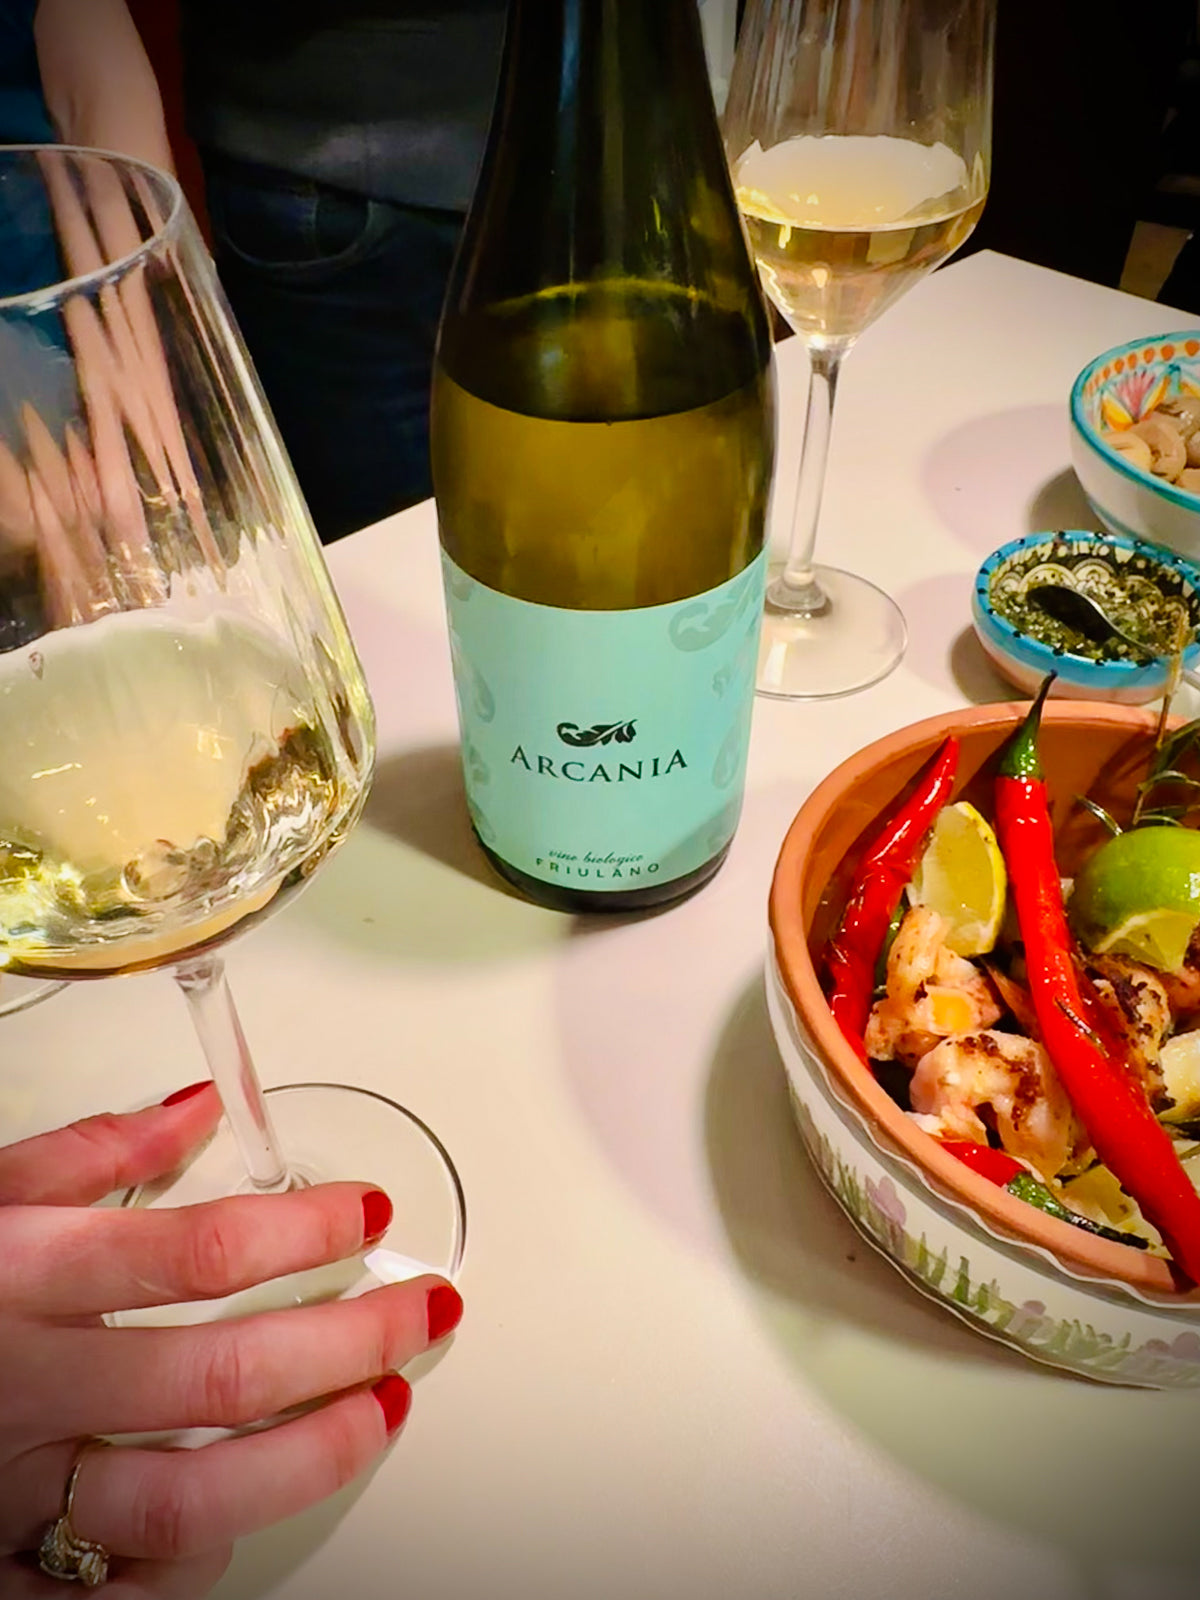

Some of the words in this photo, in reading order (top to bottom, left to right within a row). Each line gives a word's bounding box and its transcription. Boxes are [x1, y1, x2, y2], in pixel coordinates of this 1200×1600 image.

[510, 744, 688, 783] ARCANIA
[535, 857, 660, 878] FRIULANO
[548, 849, 579, 863] vino
[583, 851, 644, 867] biologico
